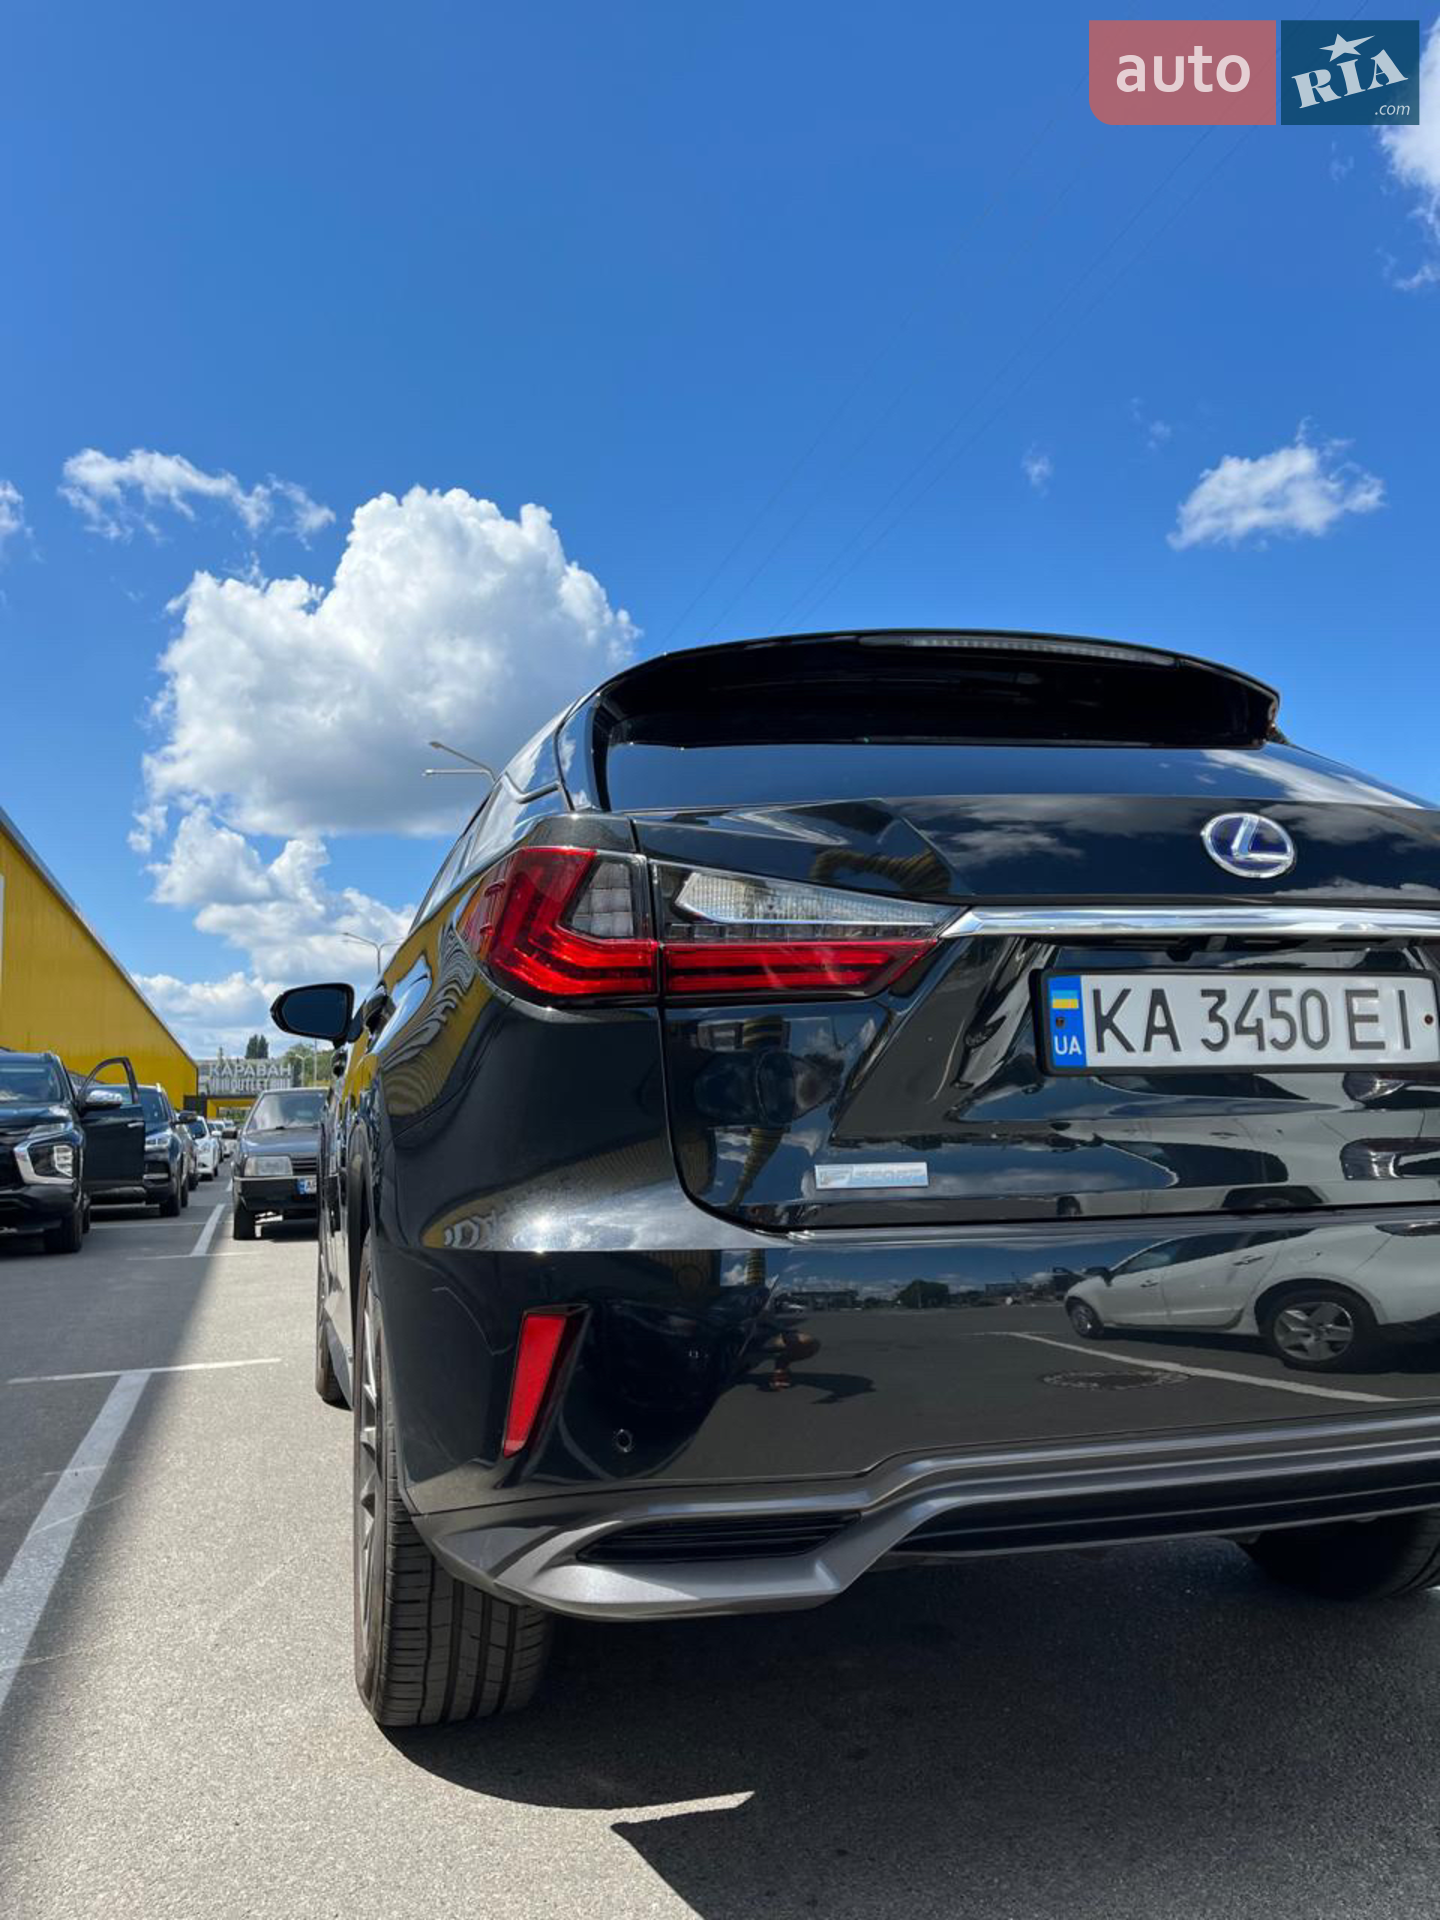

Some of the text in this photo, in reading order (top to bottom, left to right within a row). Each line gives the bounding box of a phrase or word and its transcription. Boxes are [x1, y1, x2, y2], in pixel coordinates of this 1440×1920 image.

[1092, 987, 1412, 1053] KA 3450 EI
[1053, 1034, 1082, 1056] UA
[209, 1063, 293, 1078] КАРАВАН
